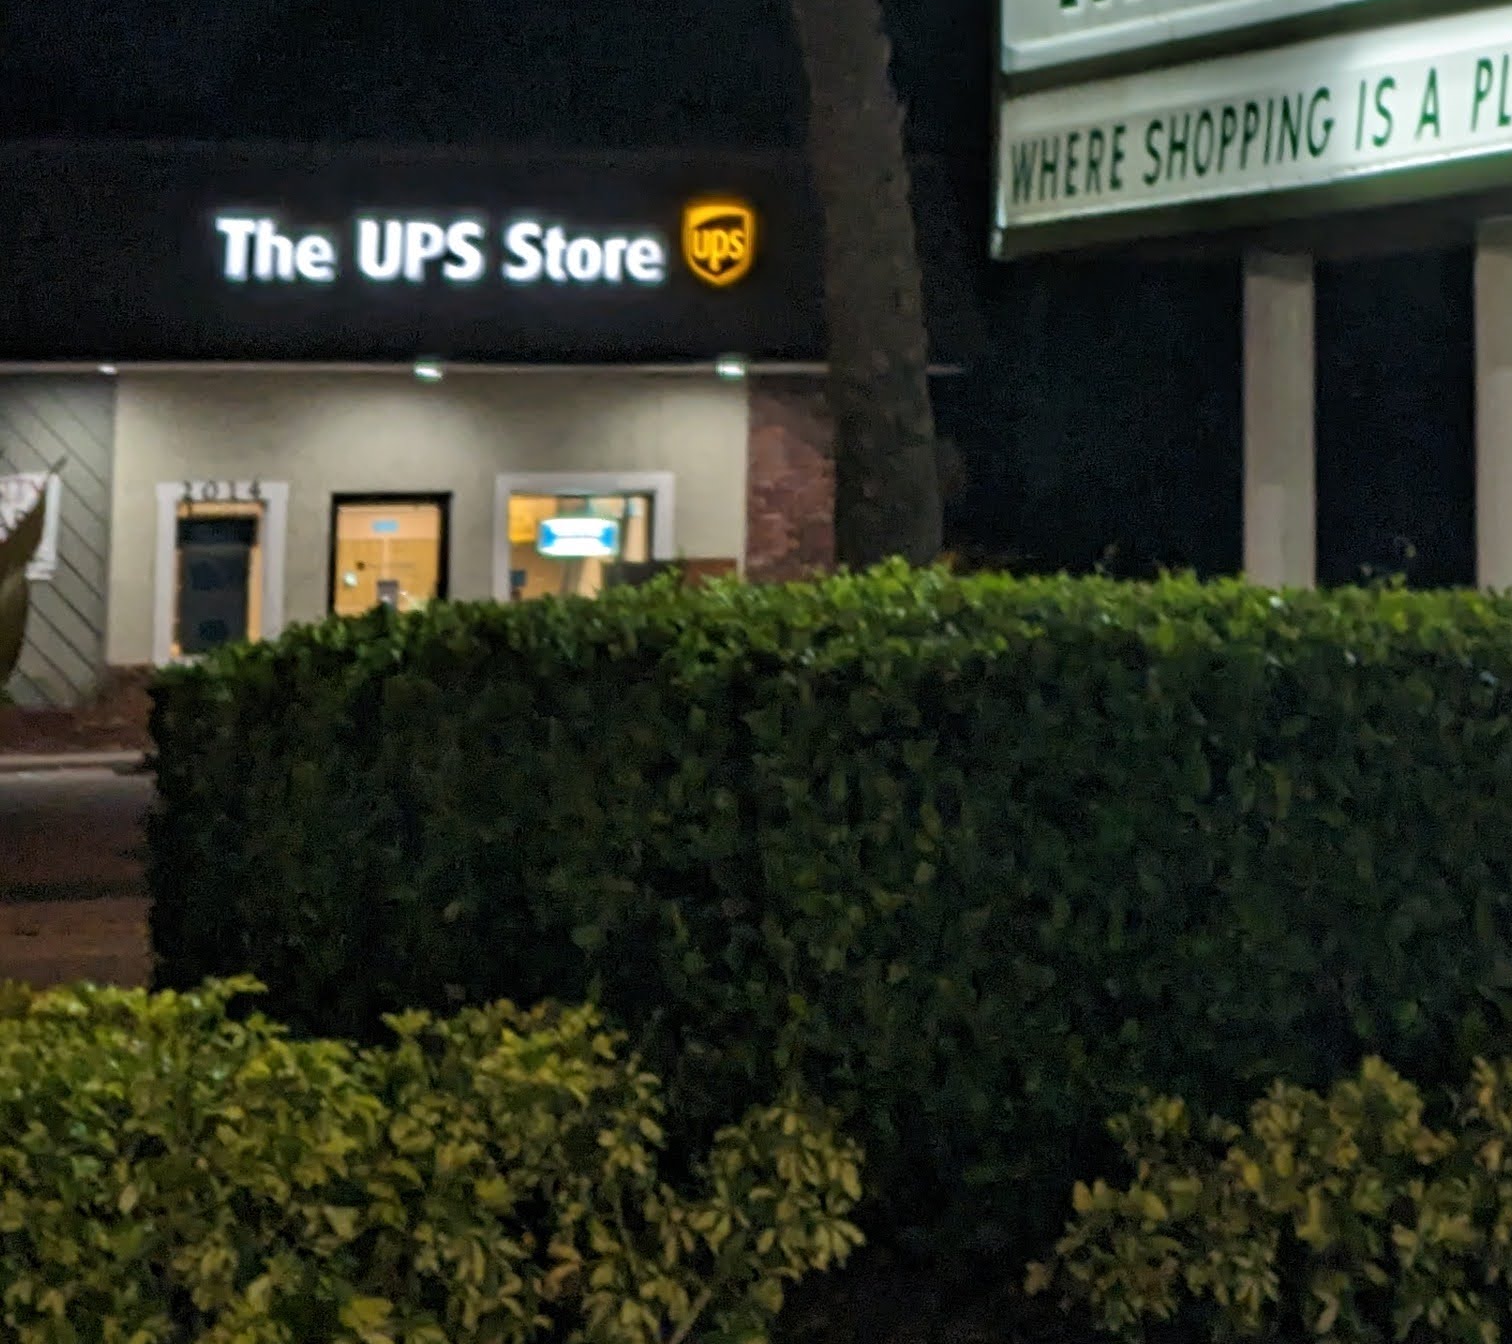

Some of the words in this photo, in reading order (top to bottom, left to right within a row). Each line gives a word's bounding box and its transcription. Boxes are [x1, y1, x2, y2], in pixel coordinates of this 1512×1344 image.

[1010, 124, 1125, 205] WHERE
[1143, 87, 1335, 188] SHOPPING
[1355, 76, 1397, 152] IS
[1415, 66, 1441, 142] A
[217, 216, 335, 282] The
[357, 218, 484, 283] UPS
[503, 220, 666, 284] Store
[693, 228, 745, 273] ups
